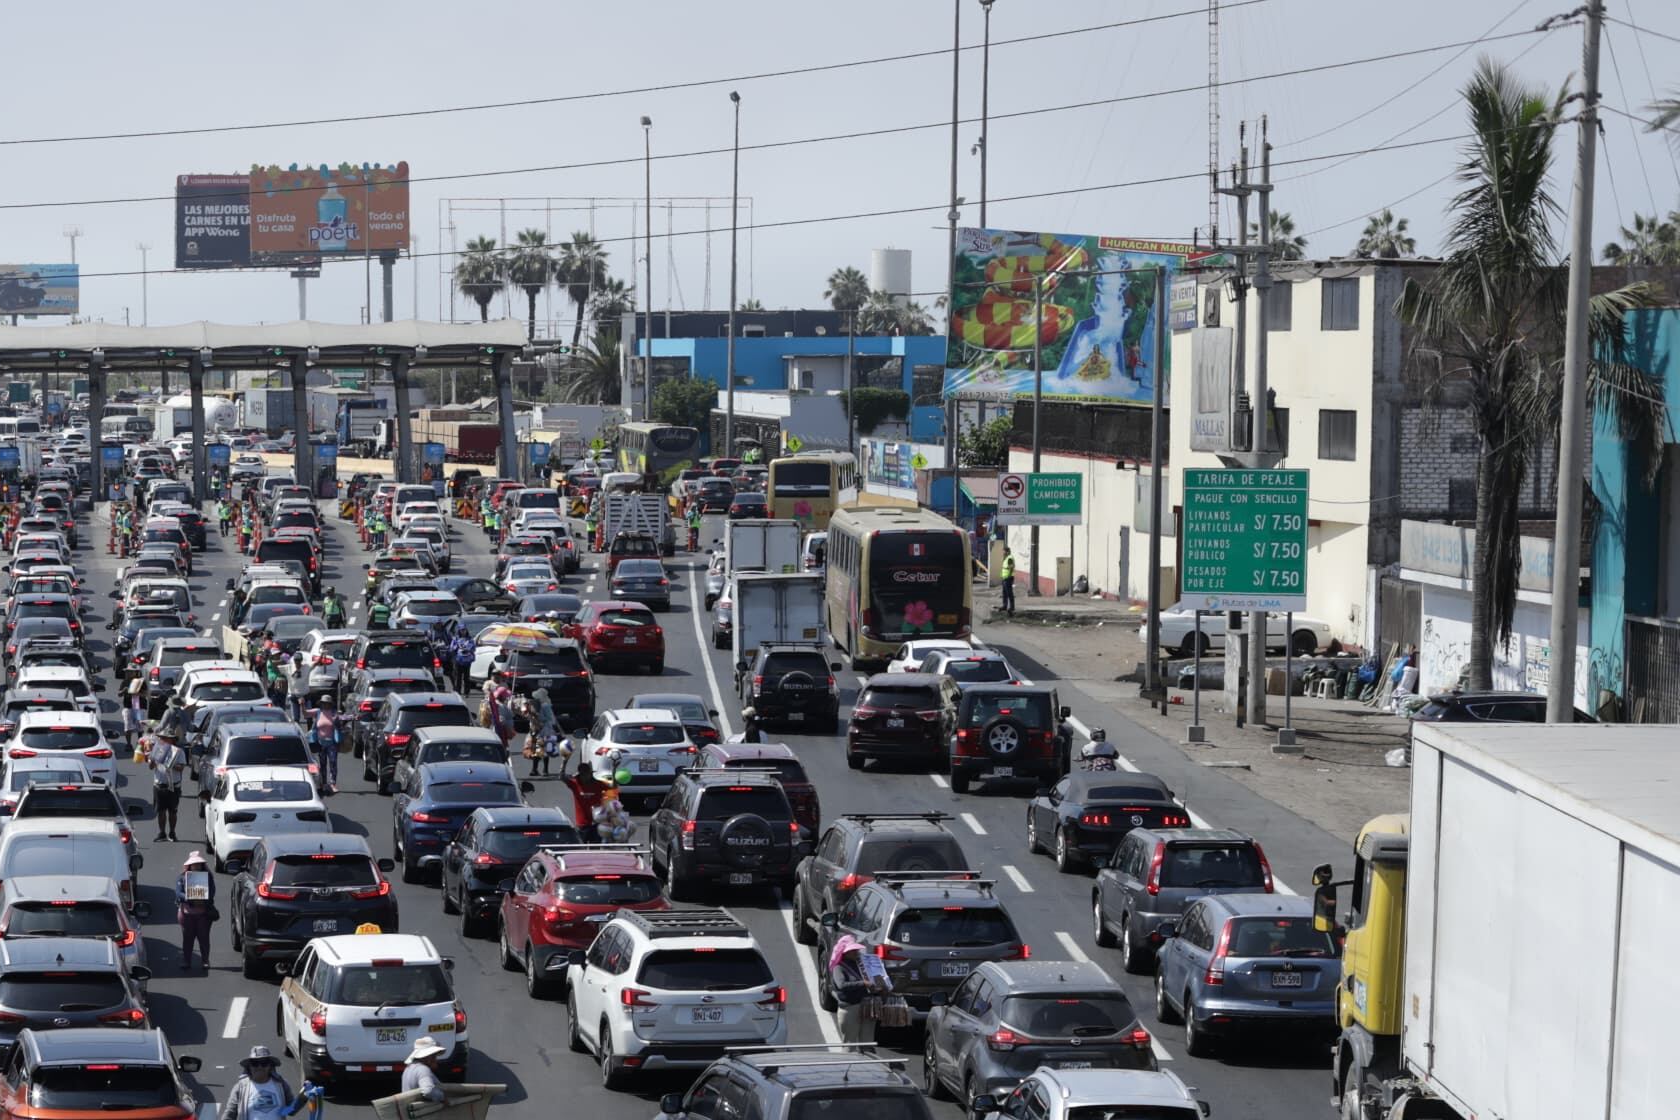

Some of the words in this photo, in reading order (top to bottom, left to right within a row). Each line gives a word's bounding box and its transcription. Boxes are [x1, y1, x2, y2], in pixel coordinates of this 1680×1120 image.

[184, 205, 202, 215] LAS
[204, 204, 250, 215] MEJORES
[184, 216, 223, 226] CARNES
[225, 216, 238, 225] EN
[256, 213, 296, 224] Disfruta
[258, 224, 270, 233] tu
[272, 224, 295, 233] casa
[369, 222, 404, 231] verano
[184, 227, 205, 237] APP
[206, 227, 240, 237] Wong
[309, 224, 358, 242] poett
[1032, 478, 1077, 487] PROHIBIDO
[1197, 473, 1235, 485] TARIFA
[1242, 474, 1255, 485] DE
[1261, 474, 1295, 485] PEAJE
[1033, 490, 1076, 500] CAMIONES
[1195, 493, 1224, 504] PAGUE
[1230, 494, 1248, 504] CON
[1254, 494, 1297, 504] SENCILLO
[1188, 511, 1231, 521] LIVIANOS
[1188, 522, 1246, 533] PARTICULAR
[1254, 514, 1266, 531] S/
[1272, 514, 1302, 531] 7.50
[1188, 539, 1231, 549] LIVIANOS
[1253, 542, 1266, 559] S/
[1271, 542, 1301, 559] 7.50
[1187, 566, 1227, 576] PESADOS
[1187, 578, 1205, 588] POR
[1208, 578, 1225, 588] EJE
[1253, 570, 1265, 586] S/
[1270, 570, 1300, 587] 7.50
[726, 837, 770, 848] SUZUKI
